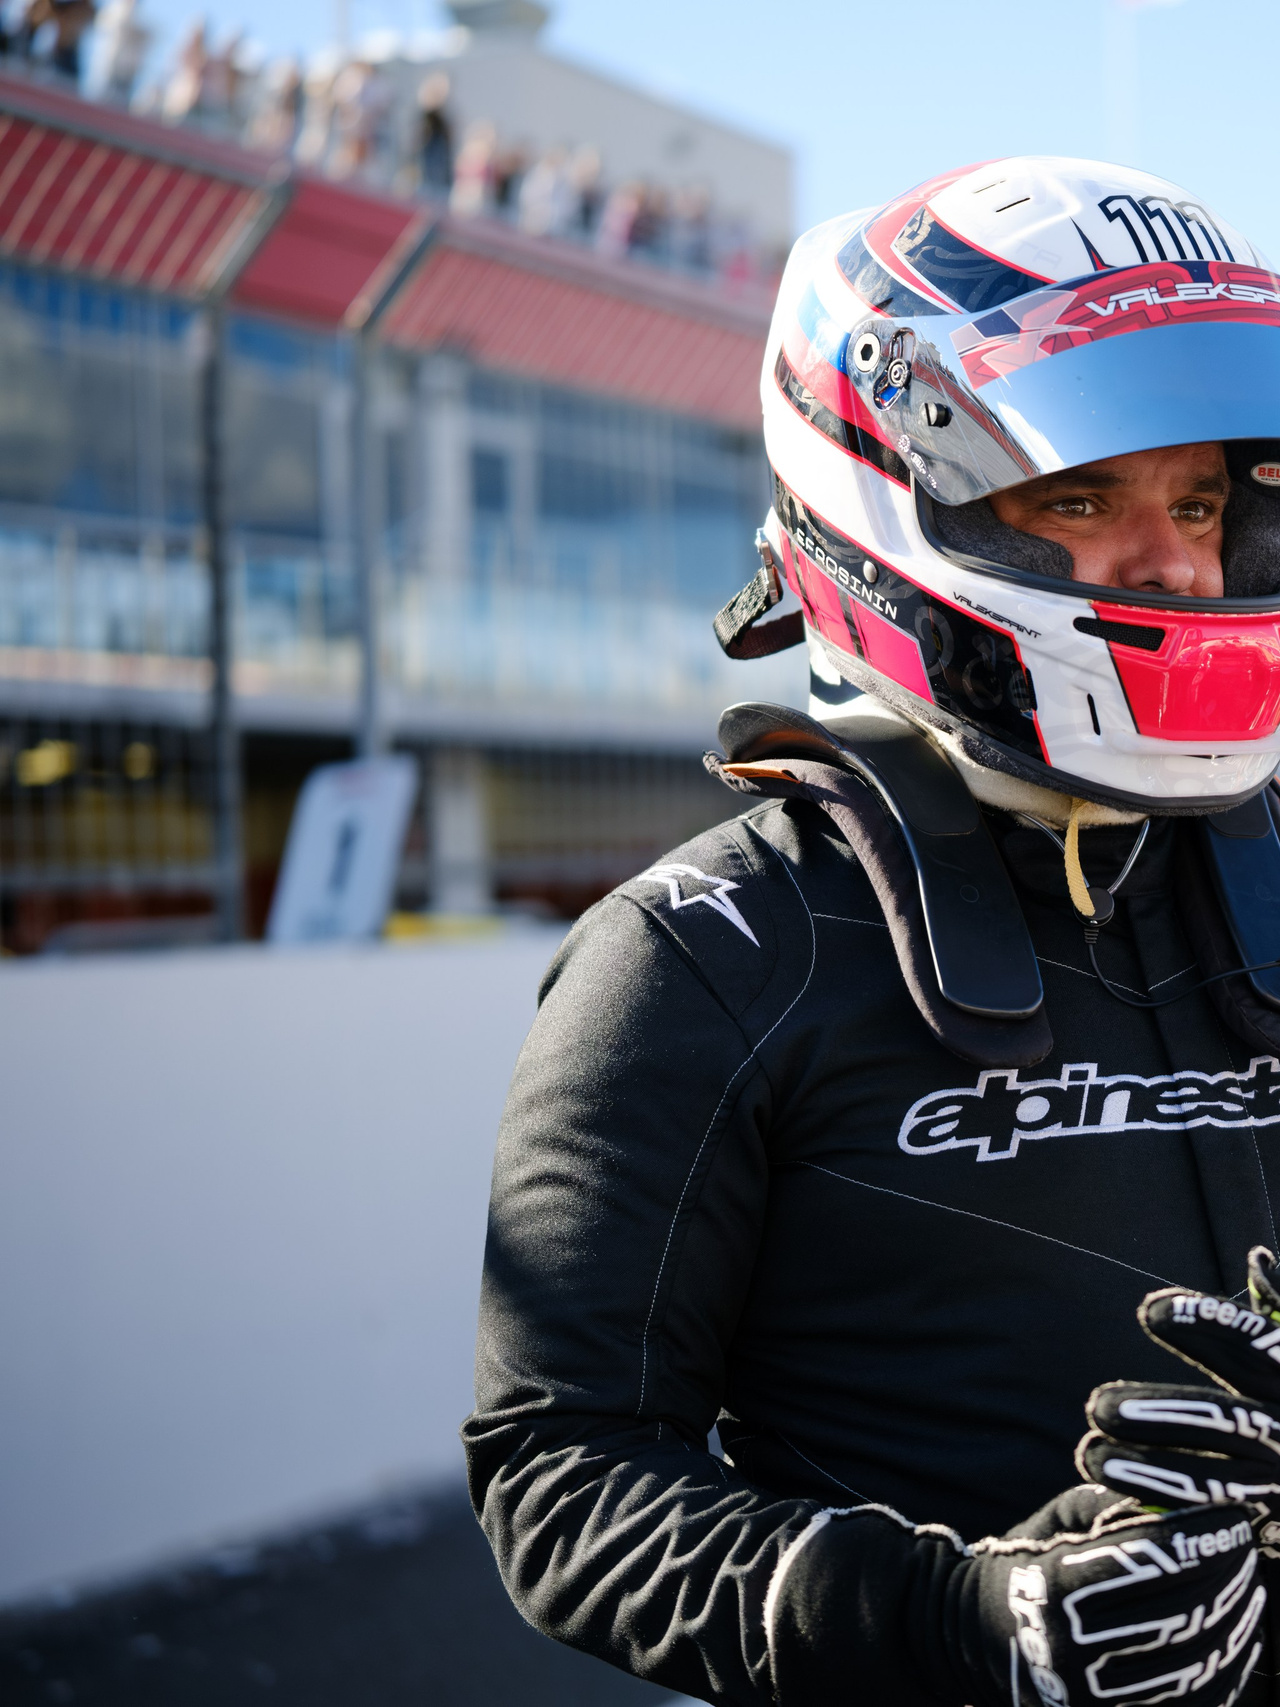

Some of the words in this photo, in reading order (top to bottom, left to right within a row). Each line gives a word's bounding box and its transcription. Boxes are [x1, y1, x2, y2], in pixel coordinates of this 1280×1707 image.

[1098, 195, 1236, 263] 111
[796, 527, 898, 620] EFROSININ
[1171, 1295, 1267, 1337] freem
[1170, 1519, 1252, 1562] freem
[1007, 1564, 1070, 1707] free
